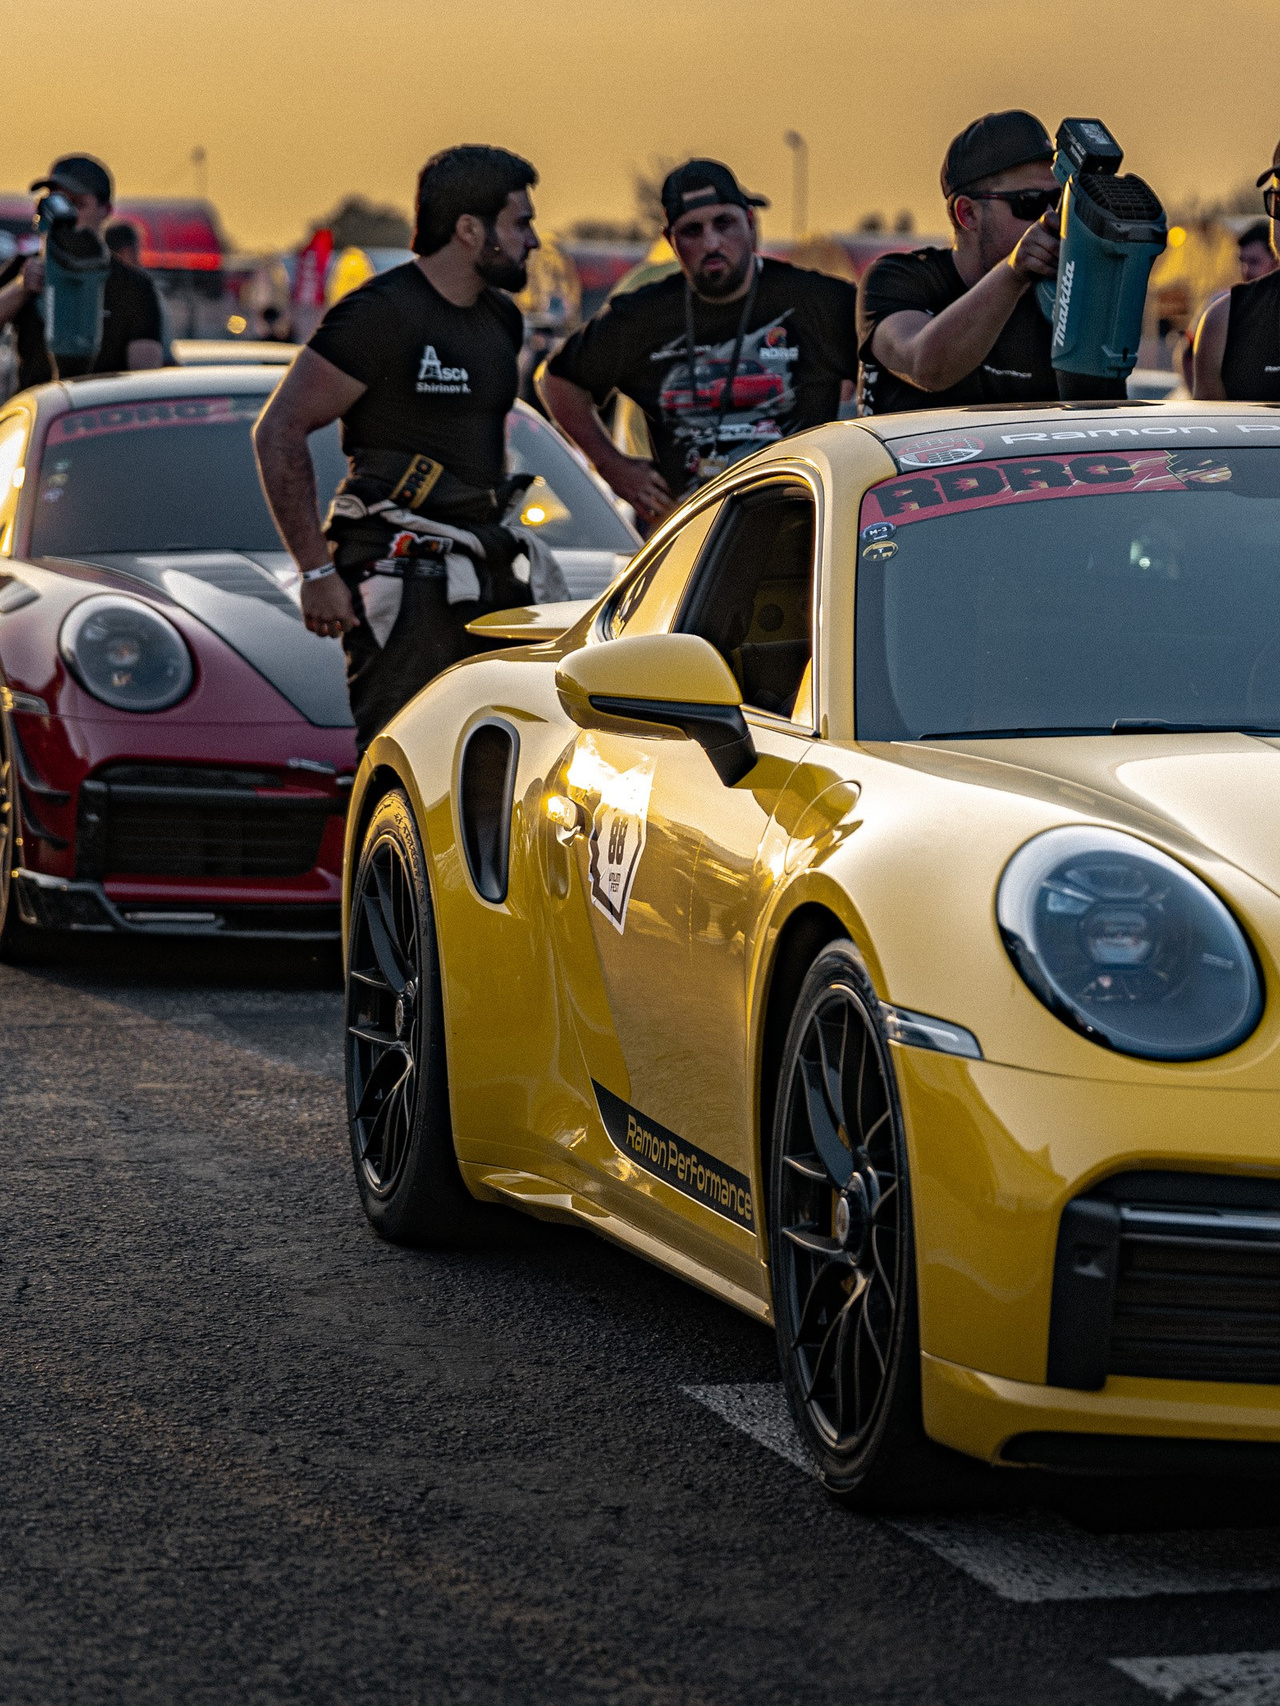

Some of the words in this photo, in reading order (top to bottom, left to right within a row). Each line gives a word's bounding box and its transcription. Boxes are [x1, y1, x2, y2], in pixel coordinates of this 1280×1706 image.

[1000, 424, 1218, 445] Ramon
[870, 454, 1136, 518] RDRC
[626, 1113, 668, 1169] Ramon
[667, 1139, 753, 1221] Performance
